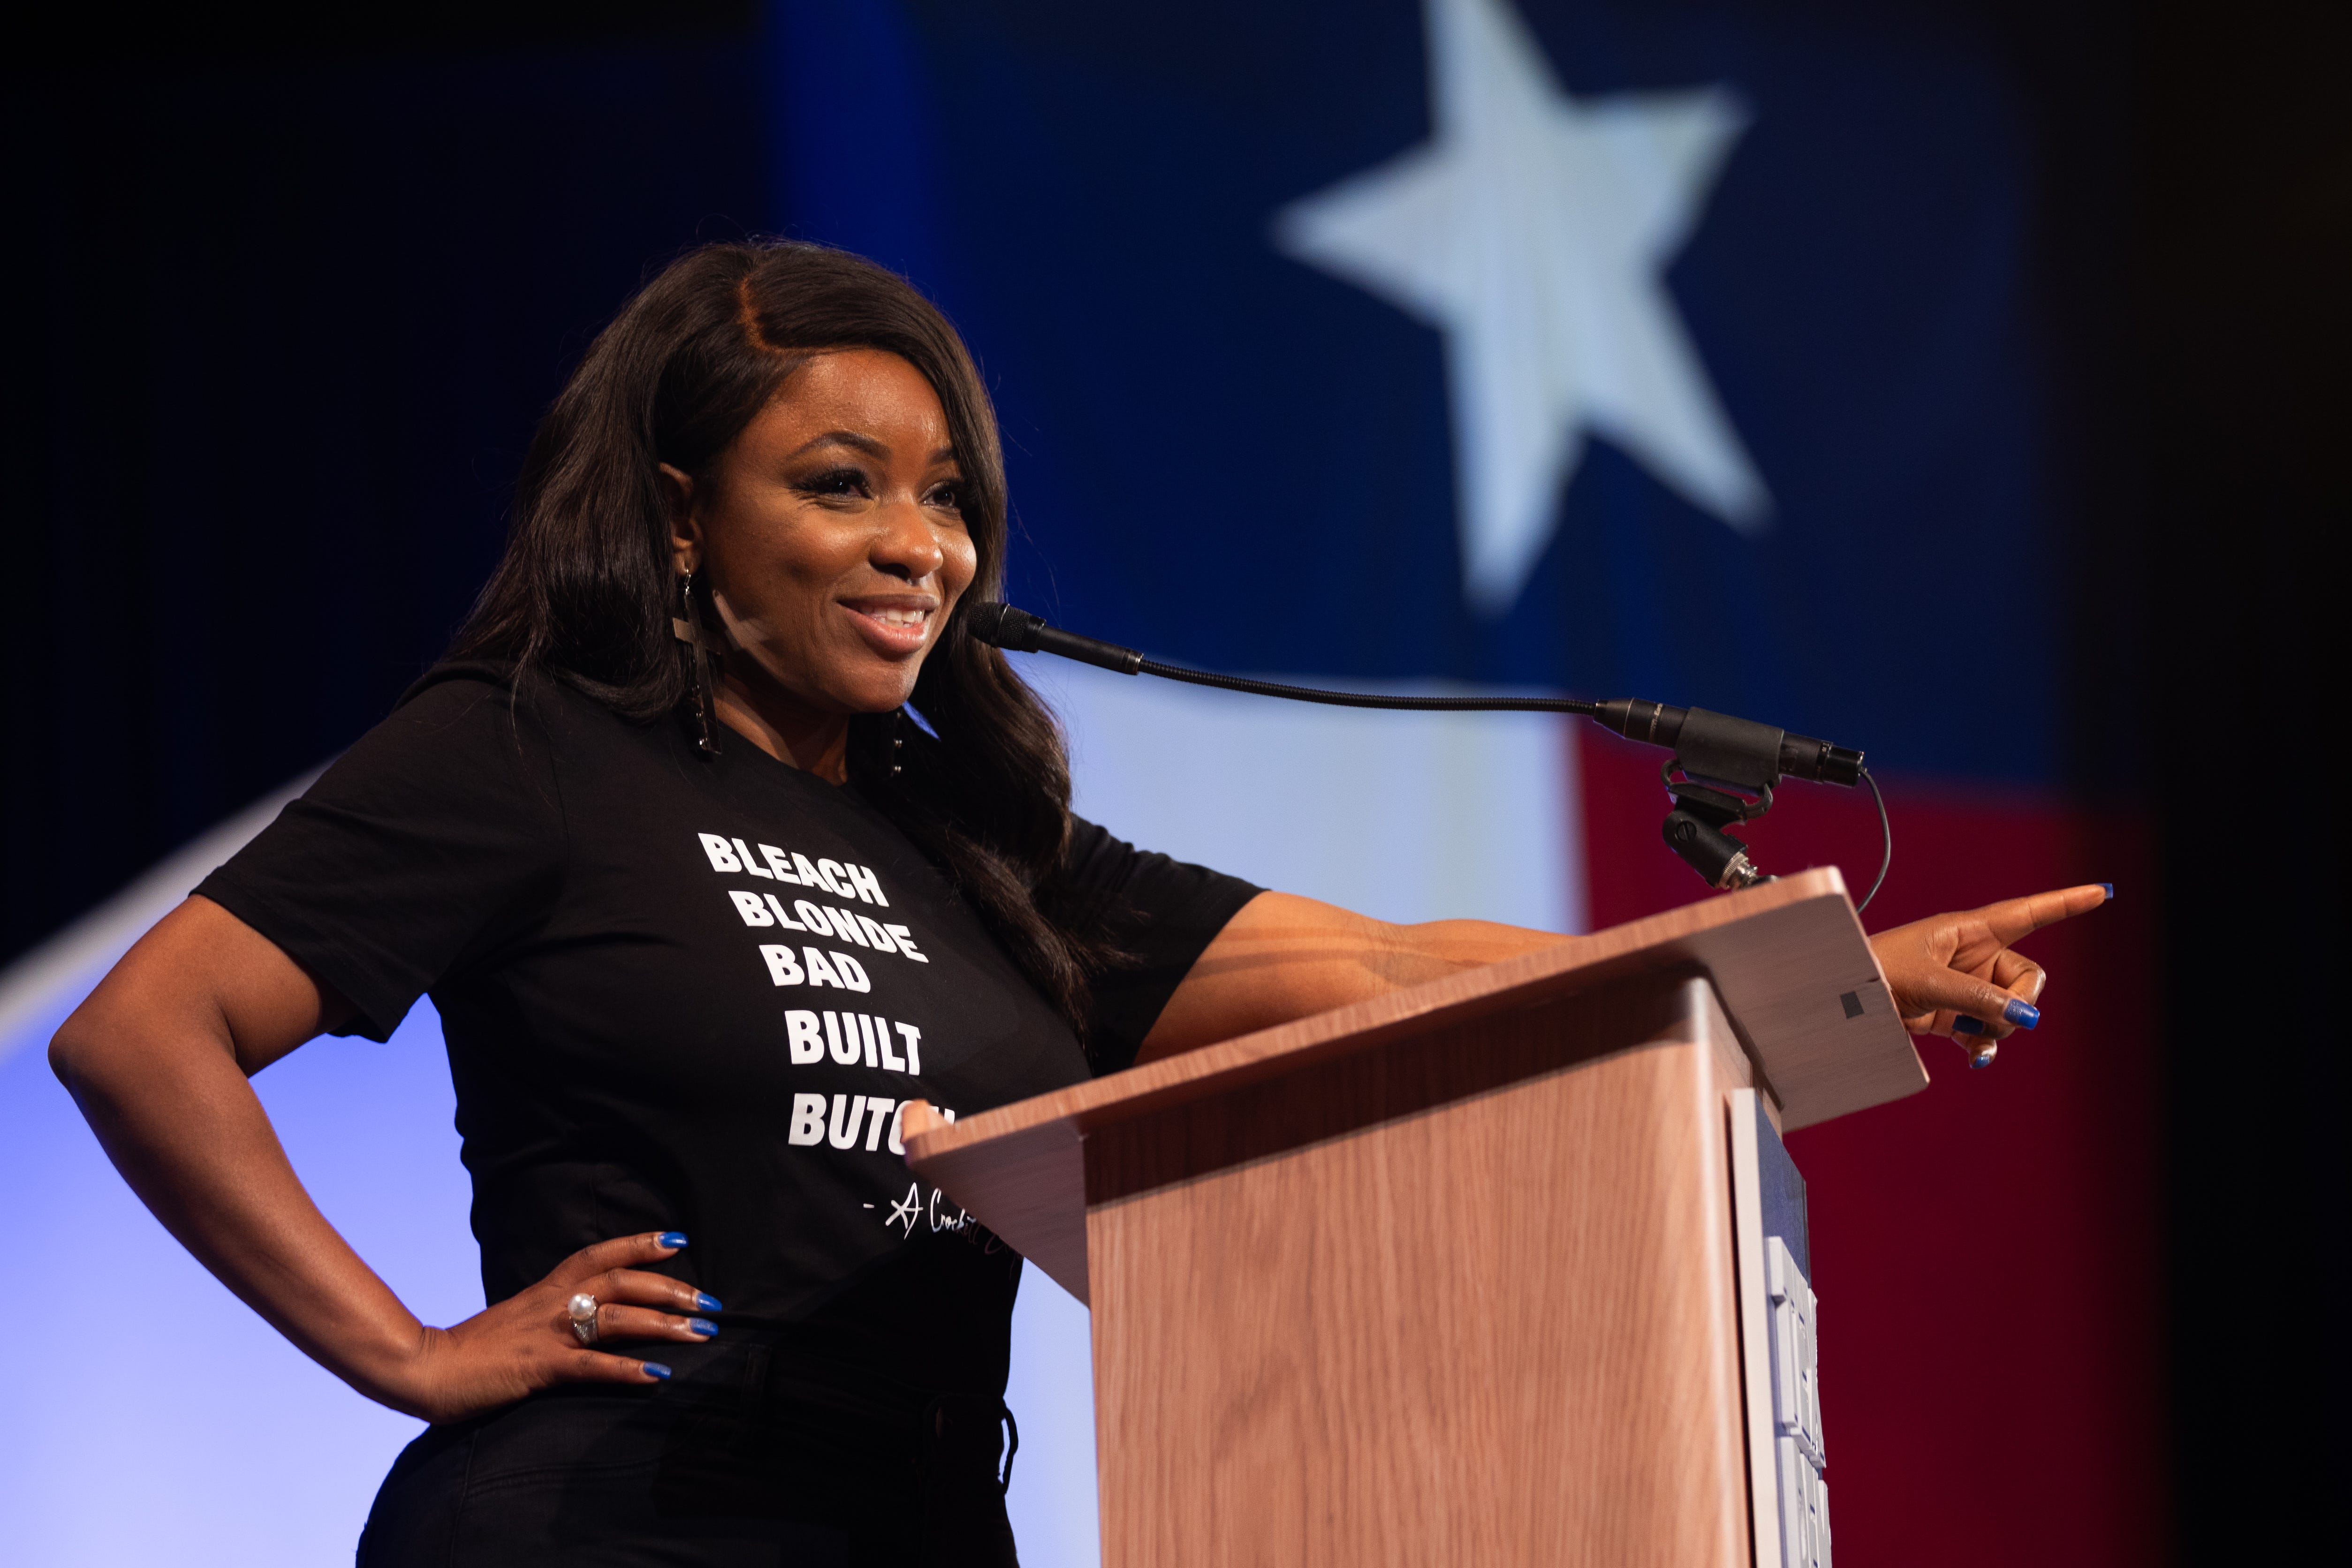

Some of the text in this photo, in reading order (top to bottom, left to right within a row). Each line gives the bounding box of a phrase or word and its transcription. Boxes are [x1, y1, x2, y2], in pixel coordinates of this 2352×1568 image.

[698, 833, 889, 907] BLEACH
[728, 890, 929, 963] BLONDE
[759, 944, 871, 993] BAD
[784, 1010, 921, 1076] BUILT
[788, 1093, 955, 1155] BUTC
